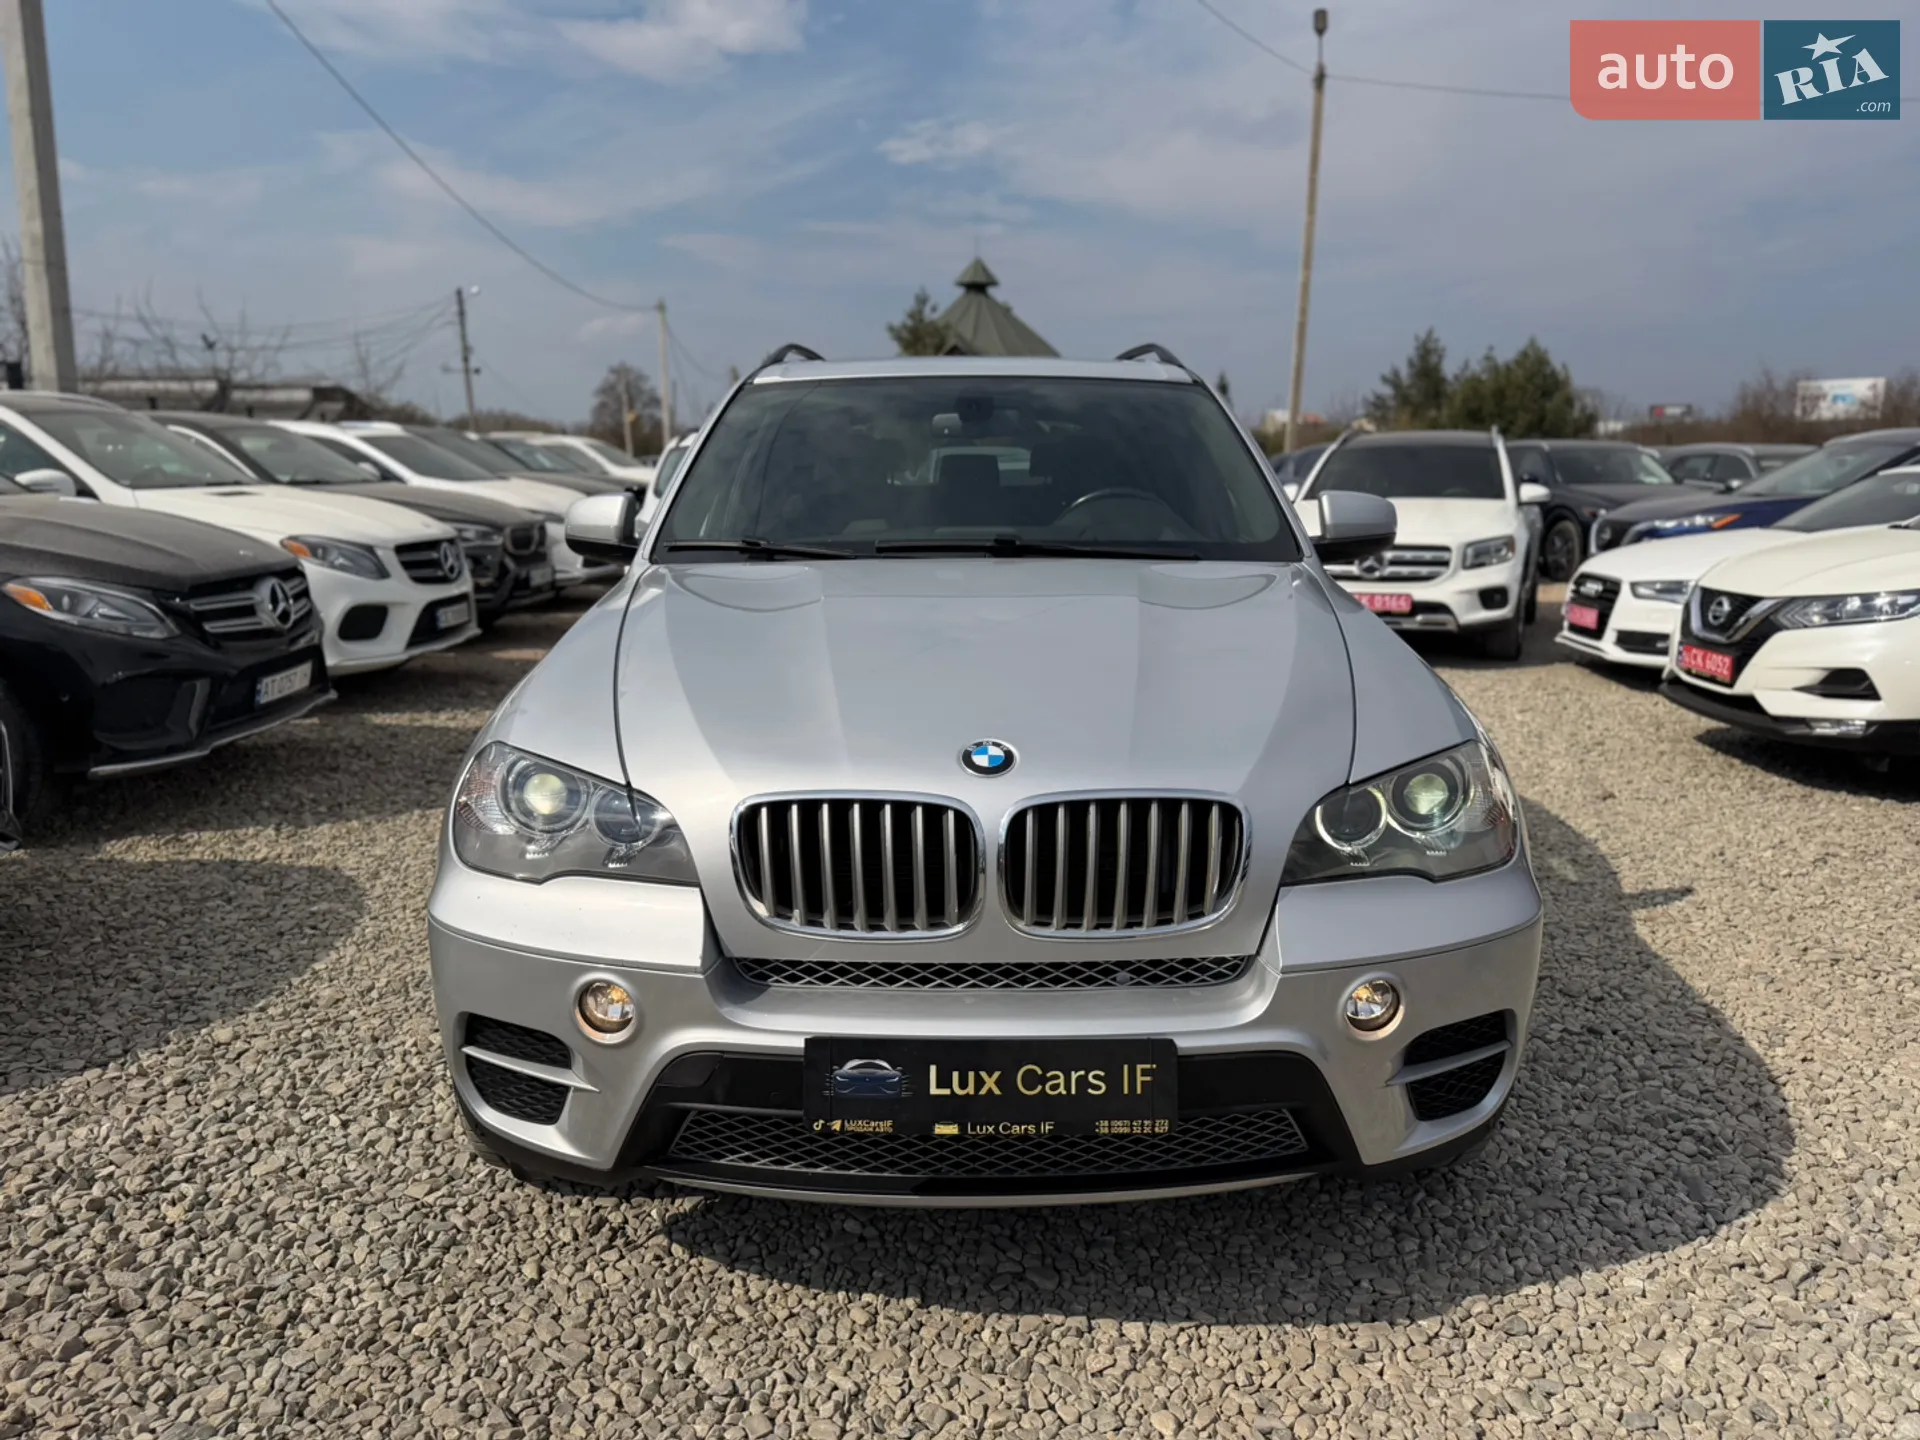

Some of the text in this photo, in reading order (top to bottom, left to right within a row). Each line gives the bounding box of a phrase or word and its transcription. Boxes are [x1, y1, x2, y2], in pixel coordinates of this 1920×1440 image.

[929, 1064, 1153, 1095] Lux Cars IF
[968, 1121, 1055, 1134] Lux Cars IF
